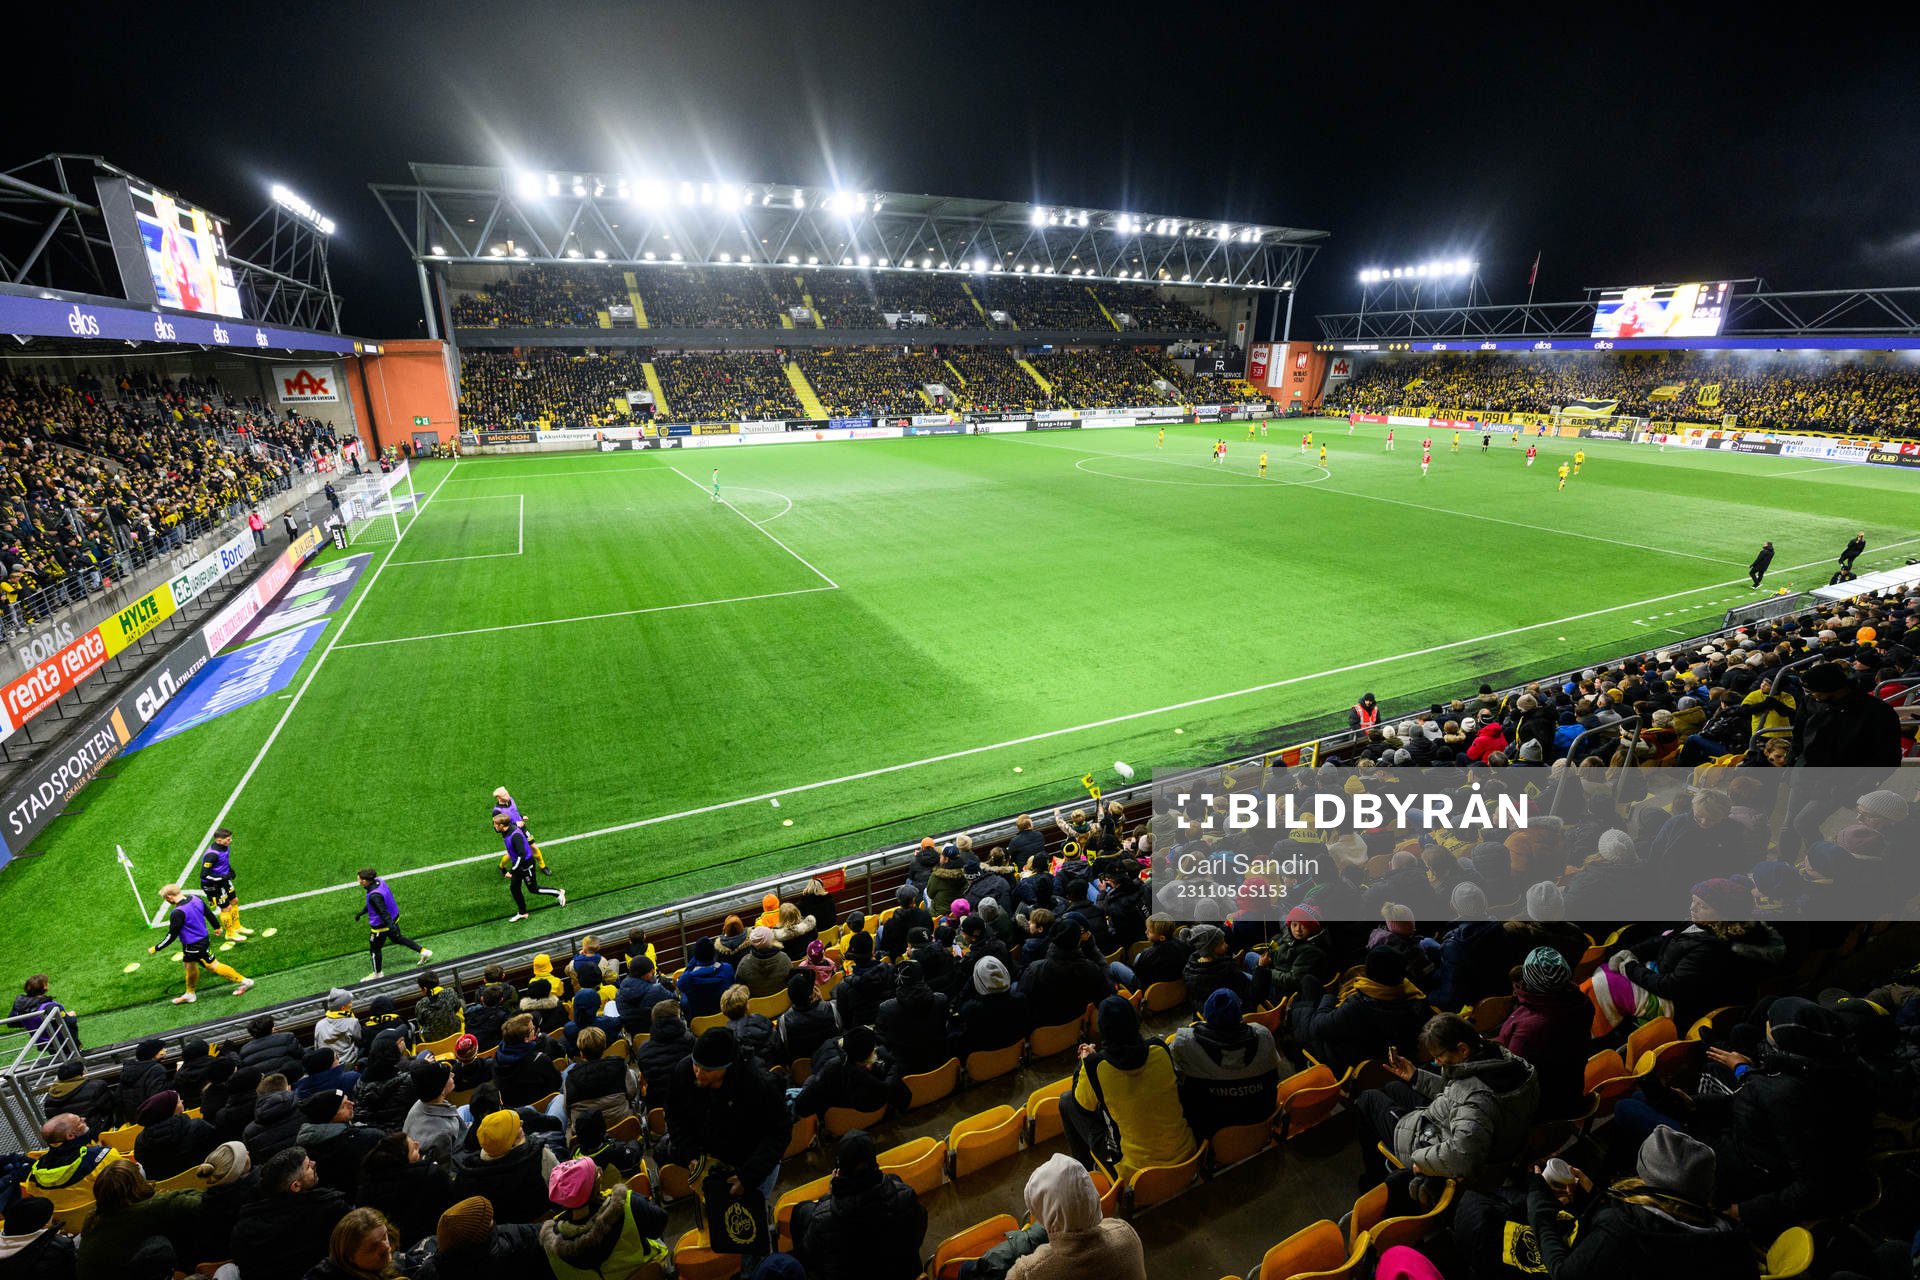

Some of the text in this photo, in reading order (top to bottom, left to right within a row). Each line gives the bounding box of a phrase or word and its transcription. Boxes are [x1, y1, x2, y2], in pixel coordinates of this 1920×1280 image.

[68, 305, 100, 336] ellos
[154, 315, 176, 340] ellos
[213, 323, 230, 345] ellos
[255, 328, 269, 347] ellos
[1481, 341, 1497, 350] ellos
[1534, 341, 1552, 350] ellos
[1594, 340, 1614, 350] ellos
[1432, 342, 1447, 351] ellos
[1333, 358, 1349, 374] MAX
[283, 368, 329, 395] MAX
[1872, 454, 1896, 462] EAB
[118, 595, 159, 635] HYLTE
[19, 620, 75, 670] BORÅS
[8, 634, 105, 715] renta renta
[175, 655, 207, 689] ATHLETICS
[8, 724, 116, 836] STADSPORTEN
[63, 776, 88, 802] LOKALER
[1208, 1083, 1264, 1097] KINGSTON
